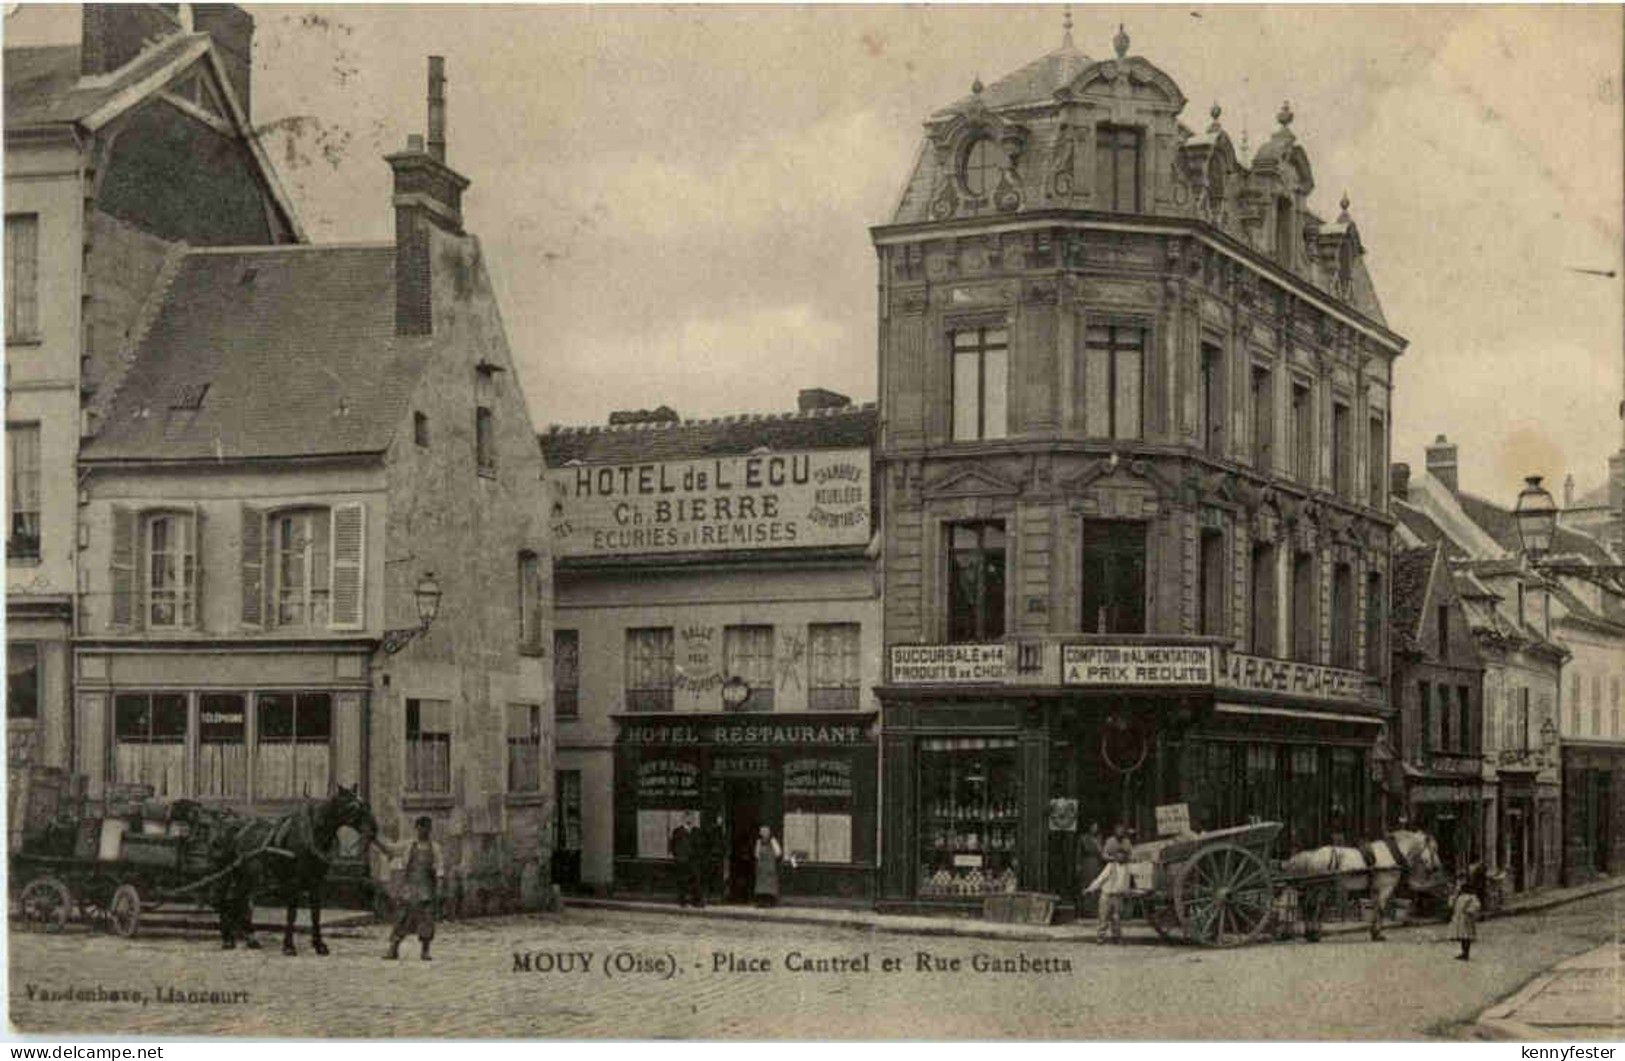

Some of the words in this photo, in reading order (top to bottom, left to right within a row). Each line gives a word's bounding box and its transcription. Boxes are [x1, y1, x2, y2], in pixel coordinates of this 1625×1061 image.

[575, 464, 675, 498] HOTEL
[682, 474, 708, 492] de
[655, 494, 779, 524] BIERRE
[702, 521, 797, 545] REMISES
[894, 649, 979, 663] SUCCURSALE
[894, 665, 957, 679] PRODUITS
[1087, 666, 1129, 681] PRIX
[627, 728, 699, 743] HOTEL
[714, 726, 862, 743] RESTAURANT
